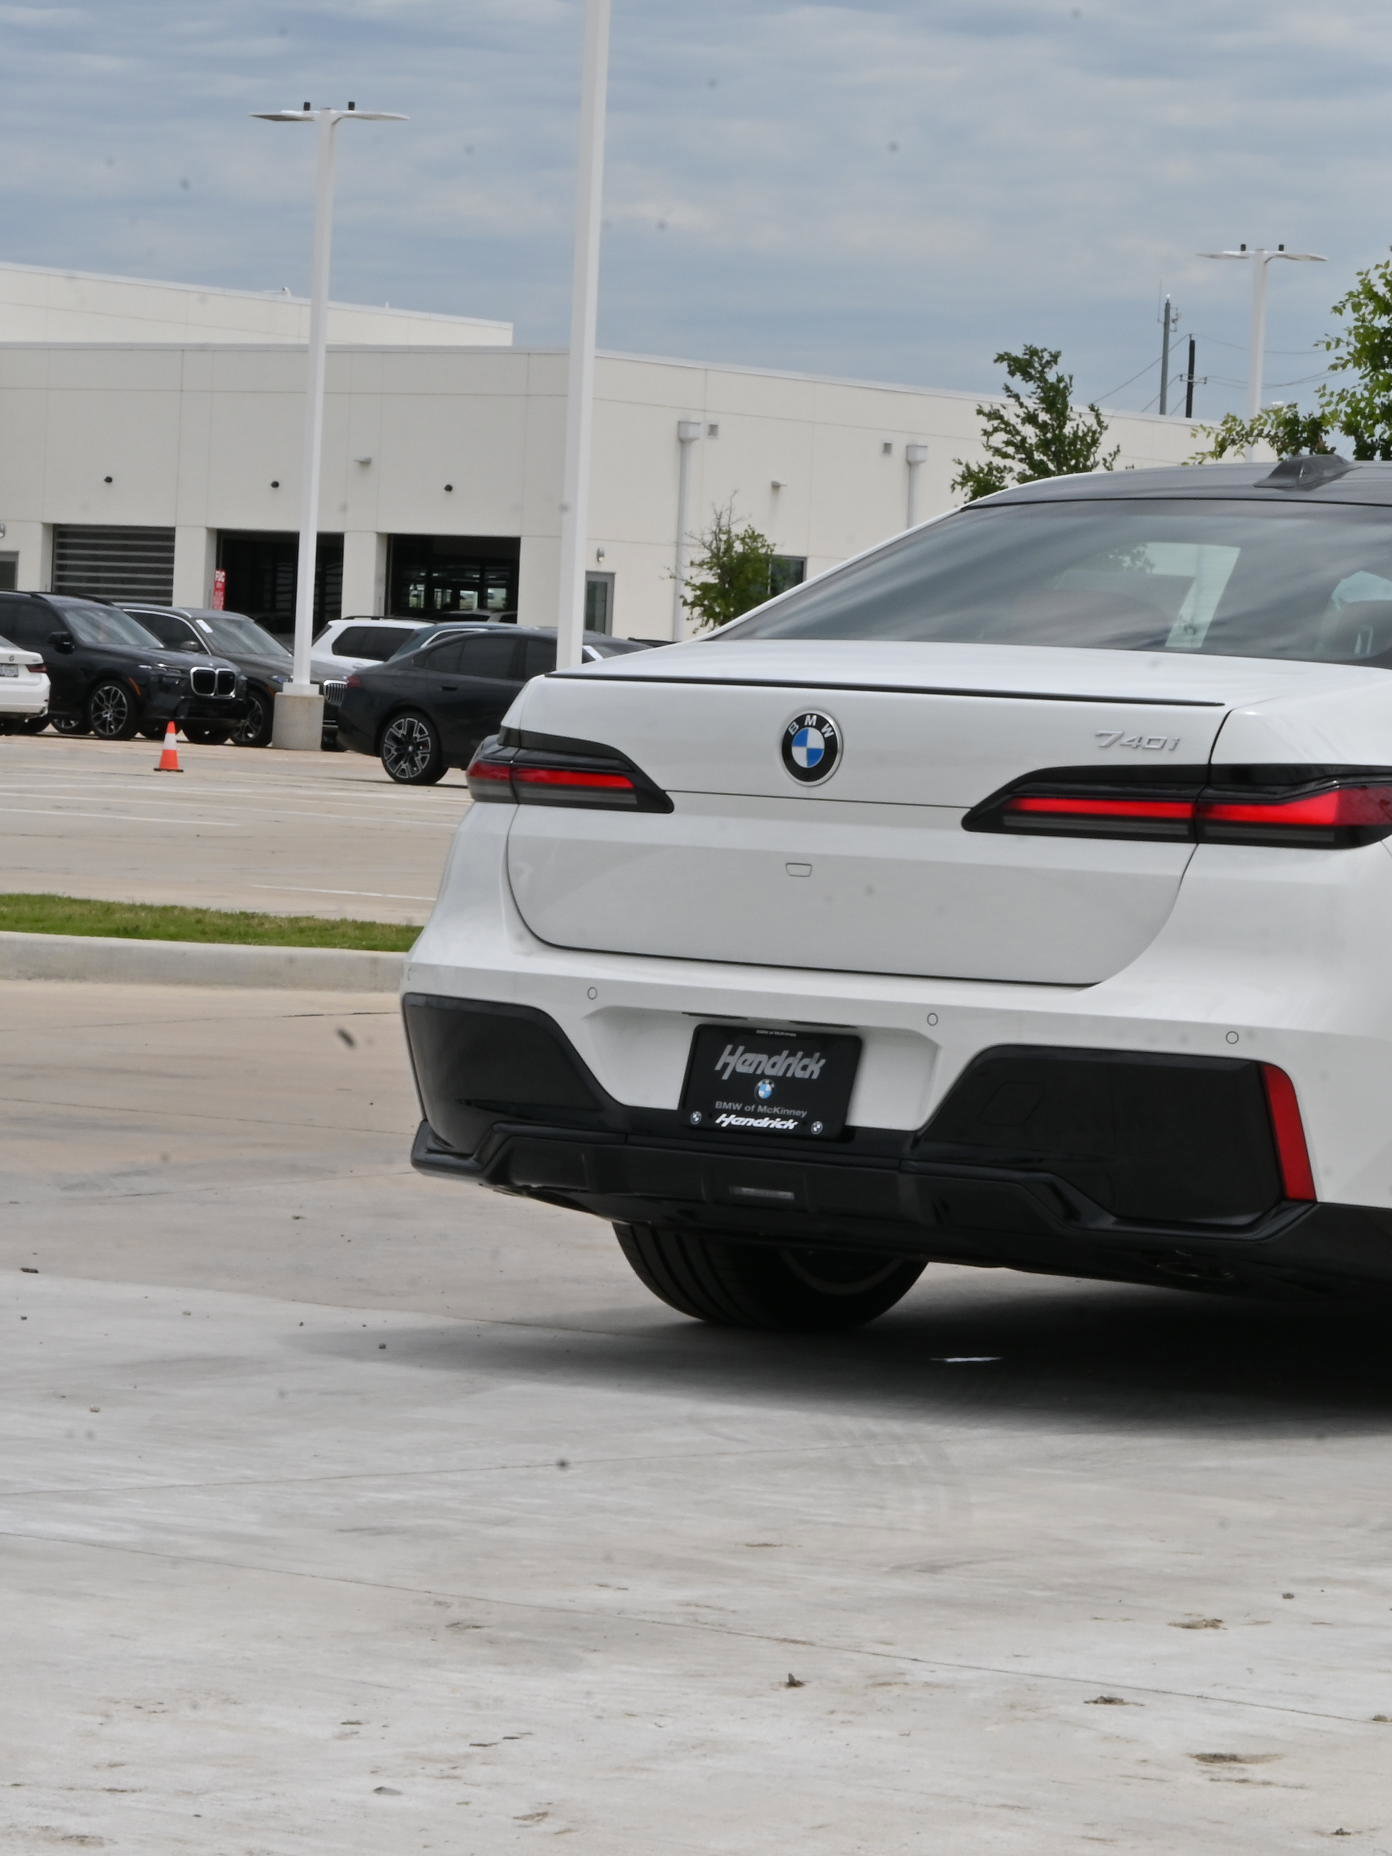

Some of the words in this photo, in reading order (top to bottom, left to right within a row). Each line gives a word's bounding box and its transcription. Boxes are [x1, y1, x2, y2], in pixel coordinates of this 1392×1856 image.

[788, 714, 835, 738] BMW
[1095, 730, 1181, 751] 740i
[714, 1044, 826, 1080] Hendrick
[715, 1100, 742, 1112] BMW
[744, 1105, 755, 1113] of
[757, 1105, 808, 1118] McKinney
[715, 1113, 799, 1130] Hendrick
